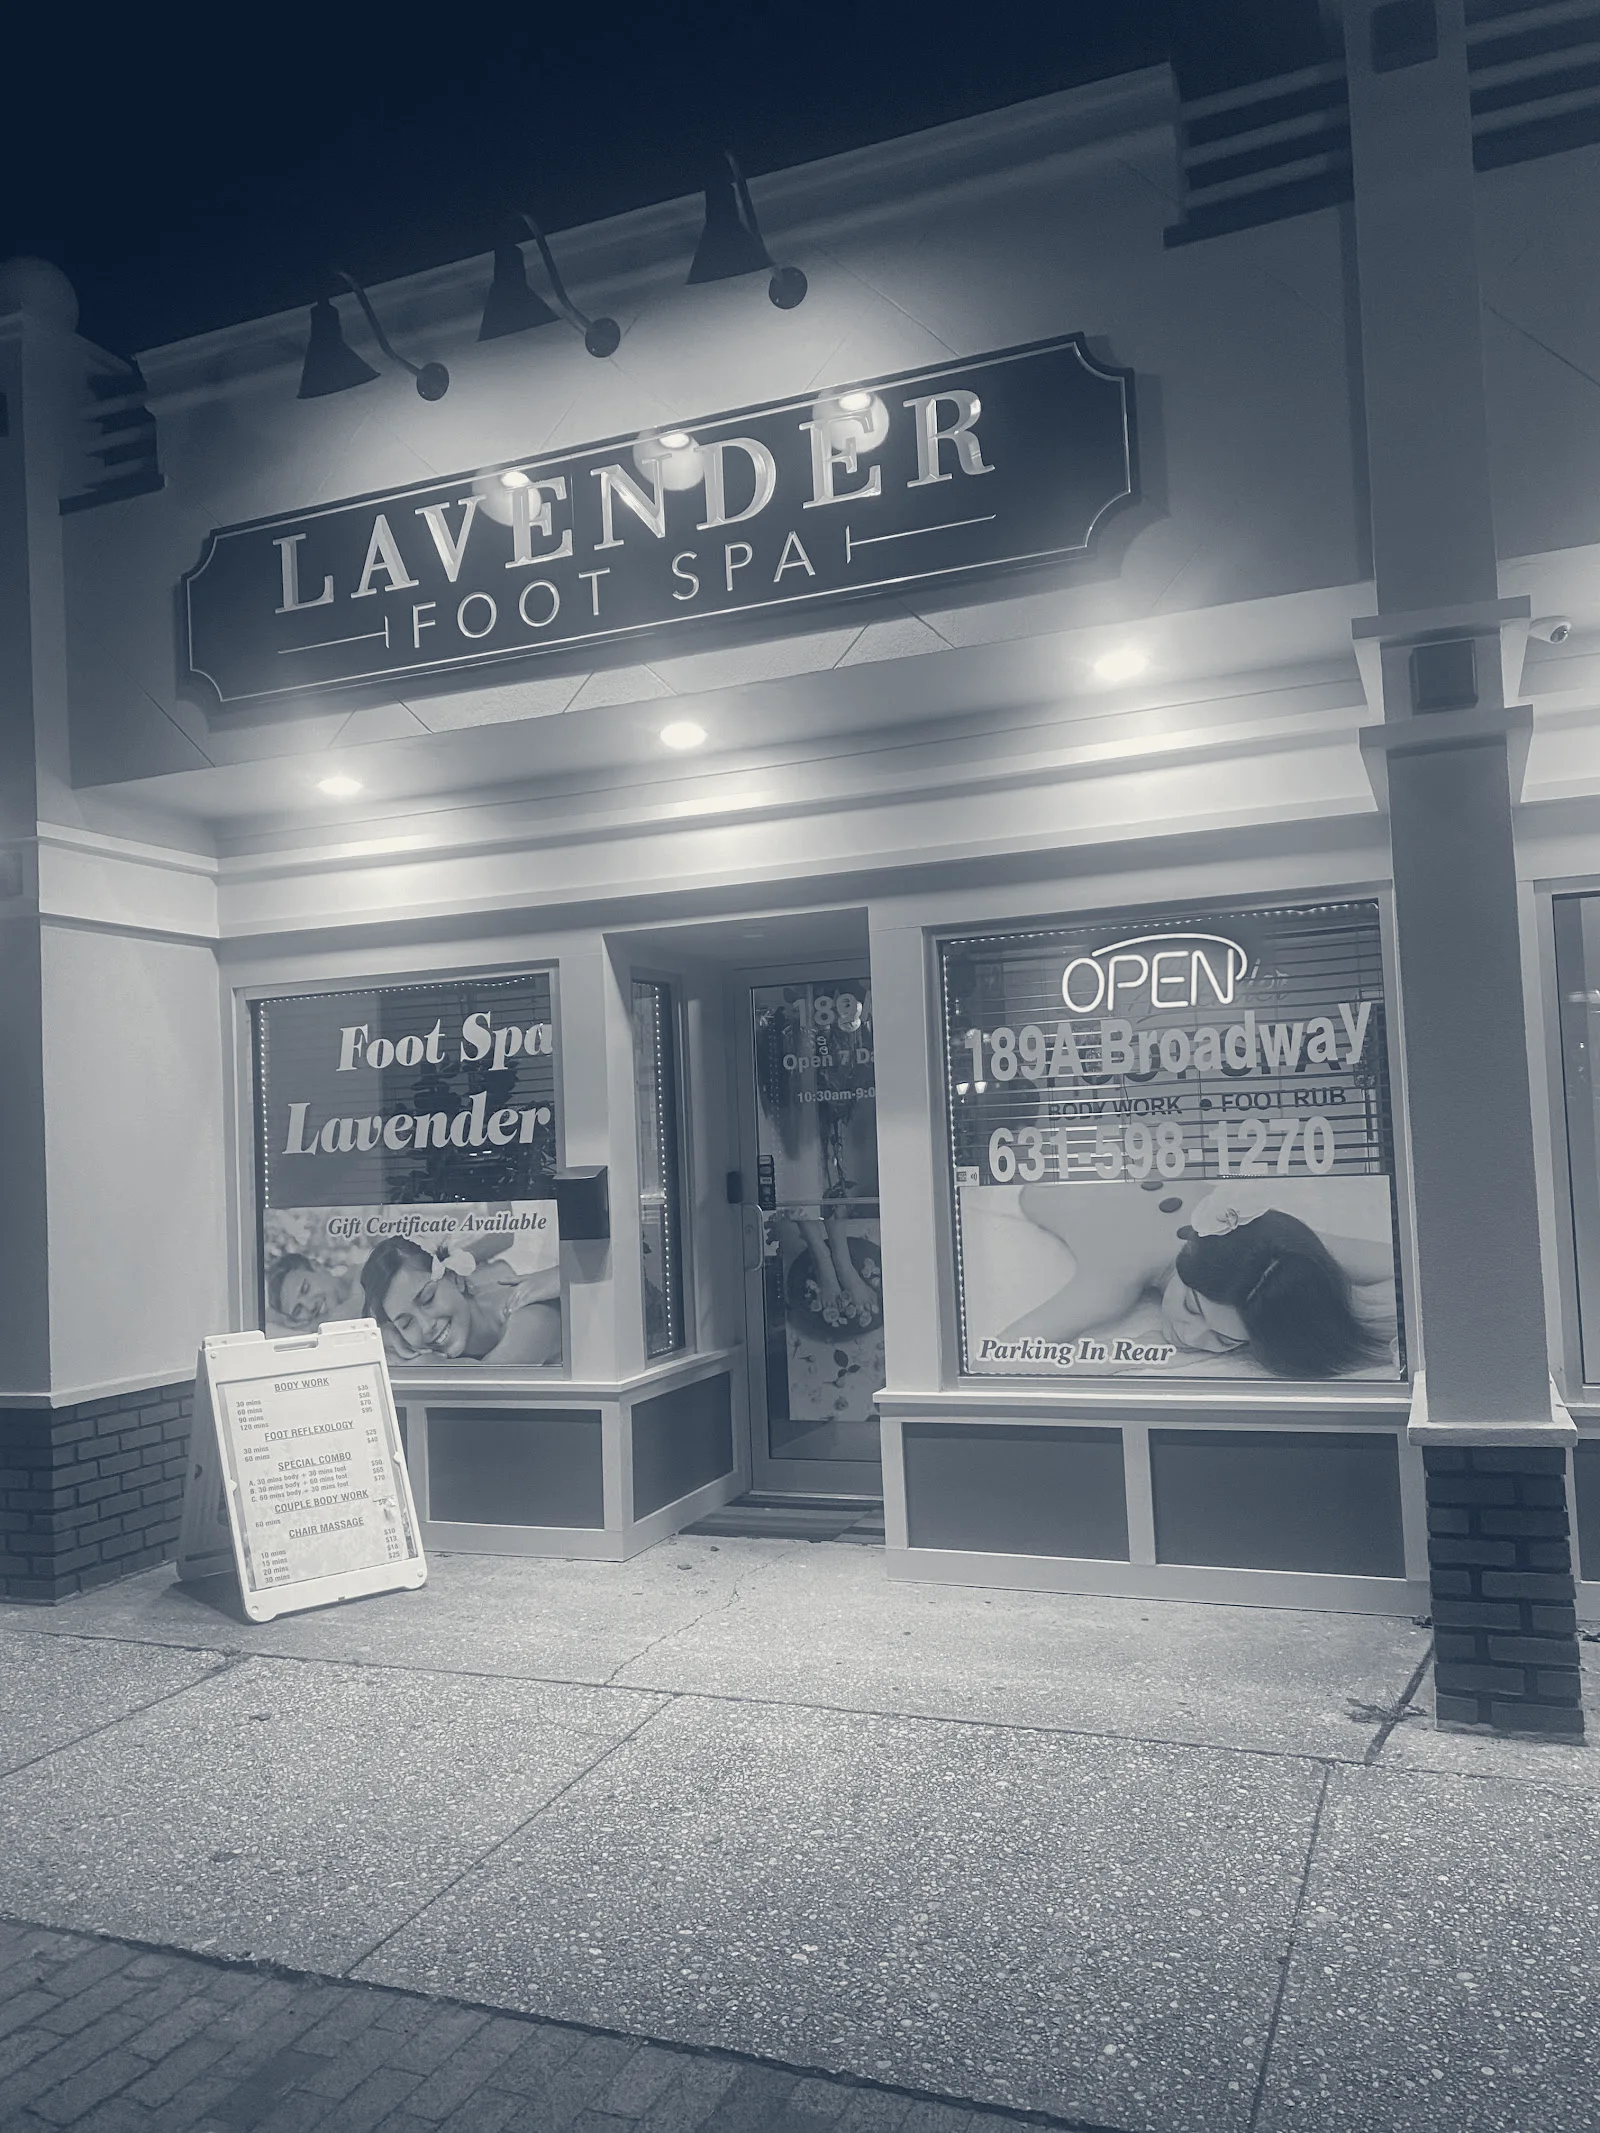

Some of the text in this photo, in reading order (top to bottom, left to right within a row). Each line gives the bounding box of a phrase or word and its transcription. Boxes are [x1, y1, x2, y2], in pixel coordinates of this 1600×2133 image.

[273, 388, 996, 614] LAVENDER
[412, 529, 817, 651] FOOT SPA
[1061, 948, 1235, 1013] OPEN
[336, 1010, 553, 1072] Foot Spa
[964, 1019, 1083, 1083] 189A
[1099, 1001, 1372, 1076] Broadway
[782, 1053, 834, 1074] Open
[838, 1049, 850, 1066] 7
[1048, 1086, 1347, 1121] BODY WORK FOOT RUB
[281, 1090, 551, 1156] Lavender
[988, 1115, 1335, 1183] 631-598-1270
[328, 1212, 547, 1237] Gift Certificate Available
[979, 1338, 1174, 1365] Parking In Rear
[274, 1377, 329, 1392] BODY WORK
[264, 1420, 354, 1441] FOOT REFLEXOLOGY
[278, 1451, 352, 1470] SPECIAL COMBO
[275, 1489, 369, 1513] COUPLE BODY WORK
[289, 1517, 364, 1538] CHAIR MASSAGE
